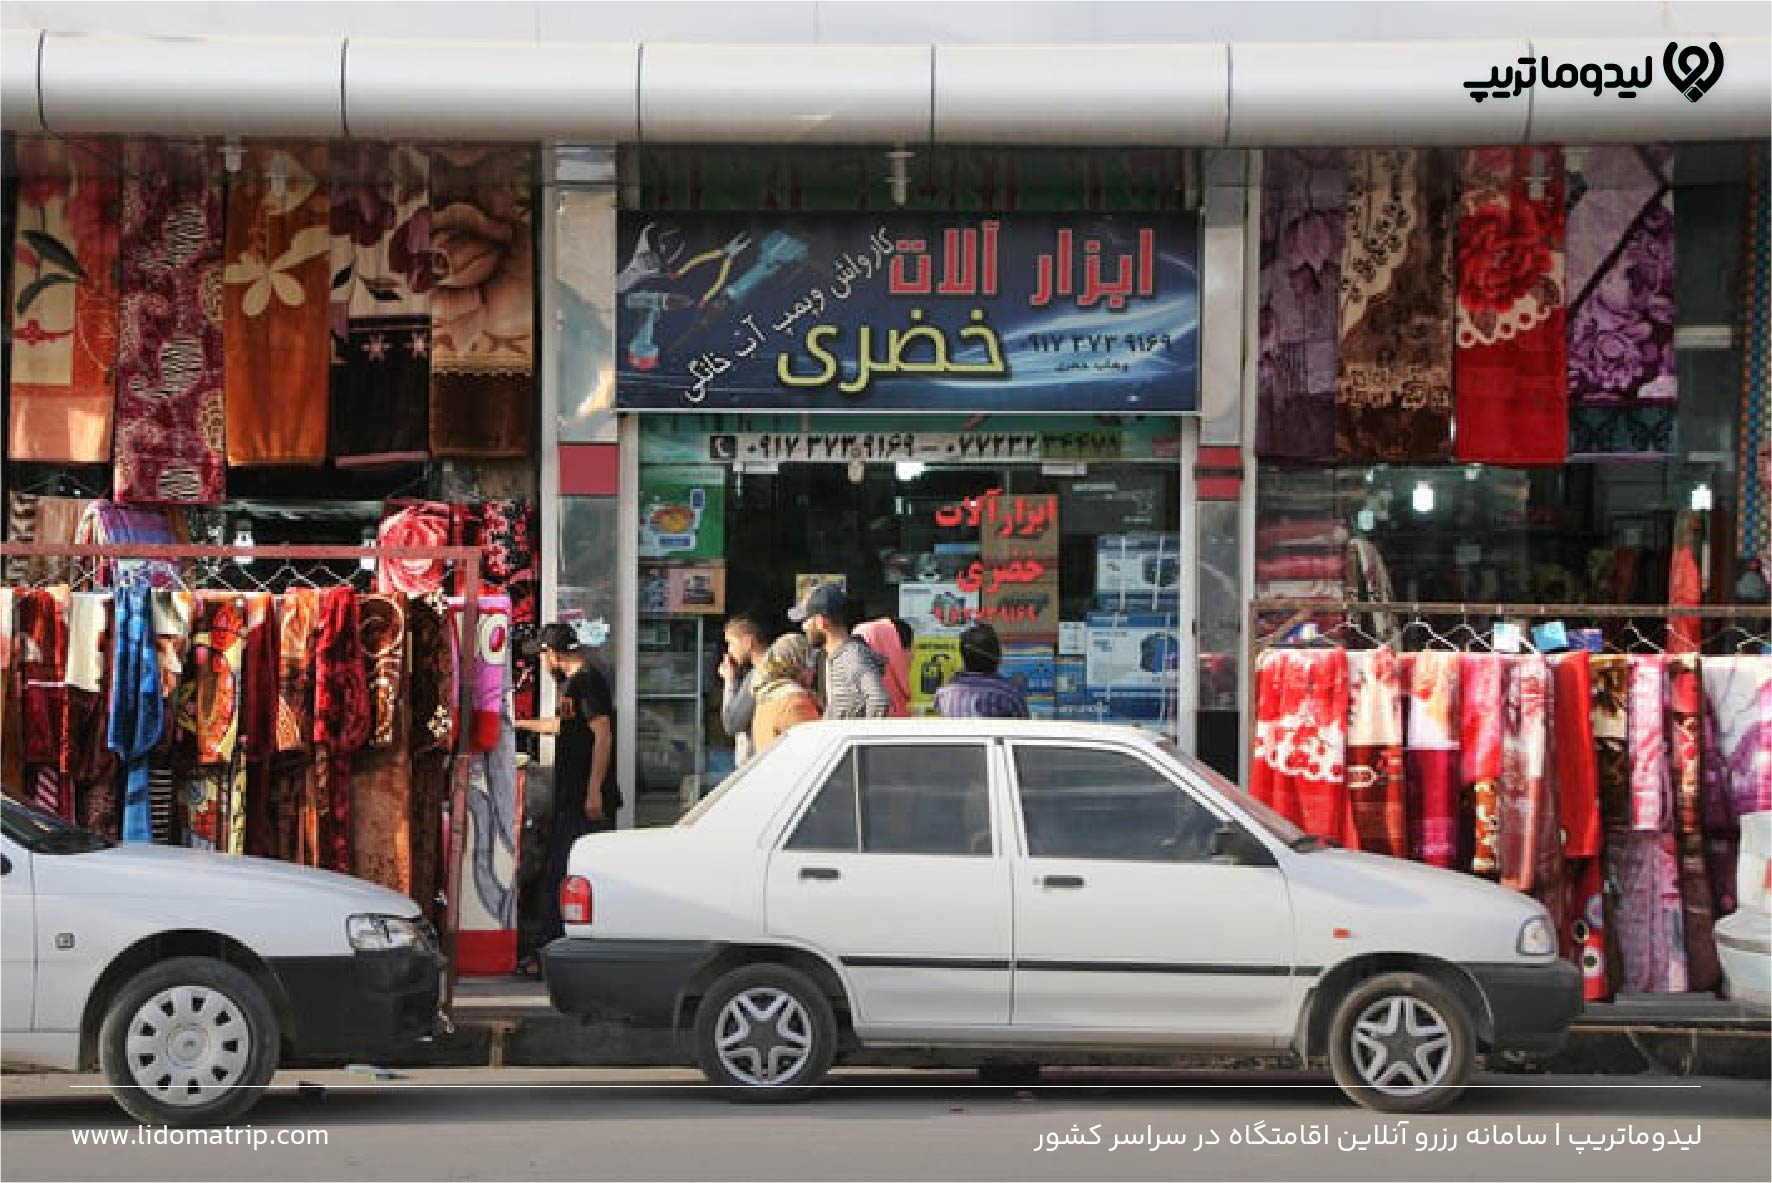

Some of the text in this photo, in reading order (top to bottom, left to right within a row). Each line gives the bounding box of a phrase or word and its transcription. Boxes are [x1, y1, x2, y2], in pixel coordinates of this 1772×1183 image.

[888, 220, 1153, 308] ابزار آلات
[734, 314, 767, 359] آب
[777, 308, 1006, 393] خضری
[995, 495, 1058, 537] ابزار
[956, 549, 1045, 593] خضری
